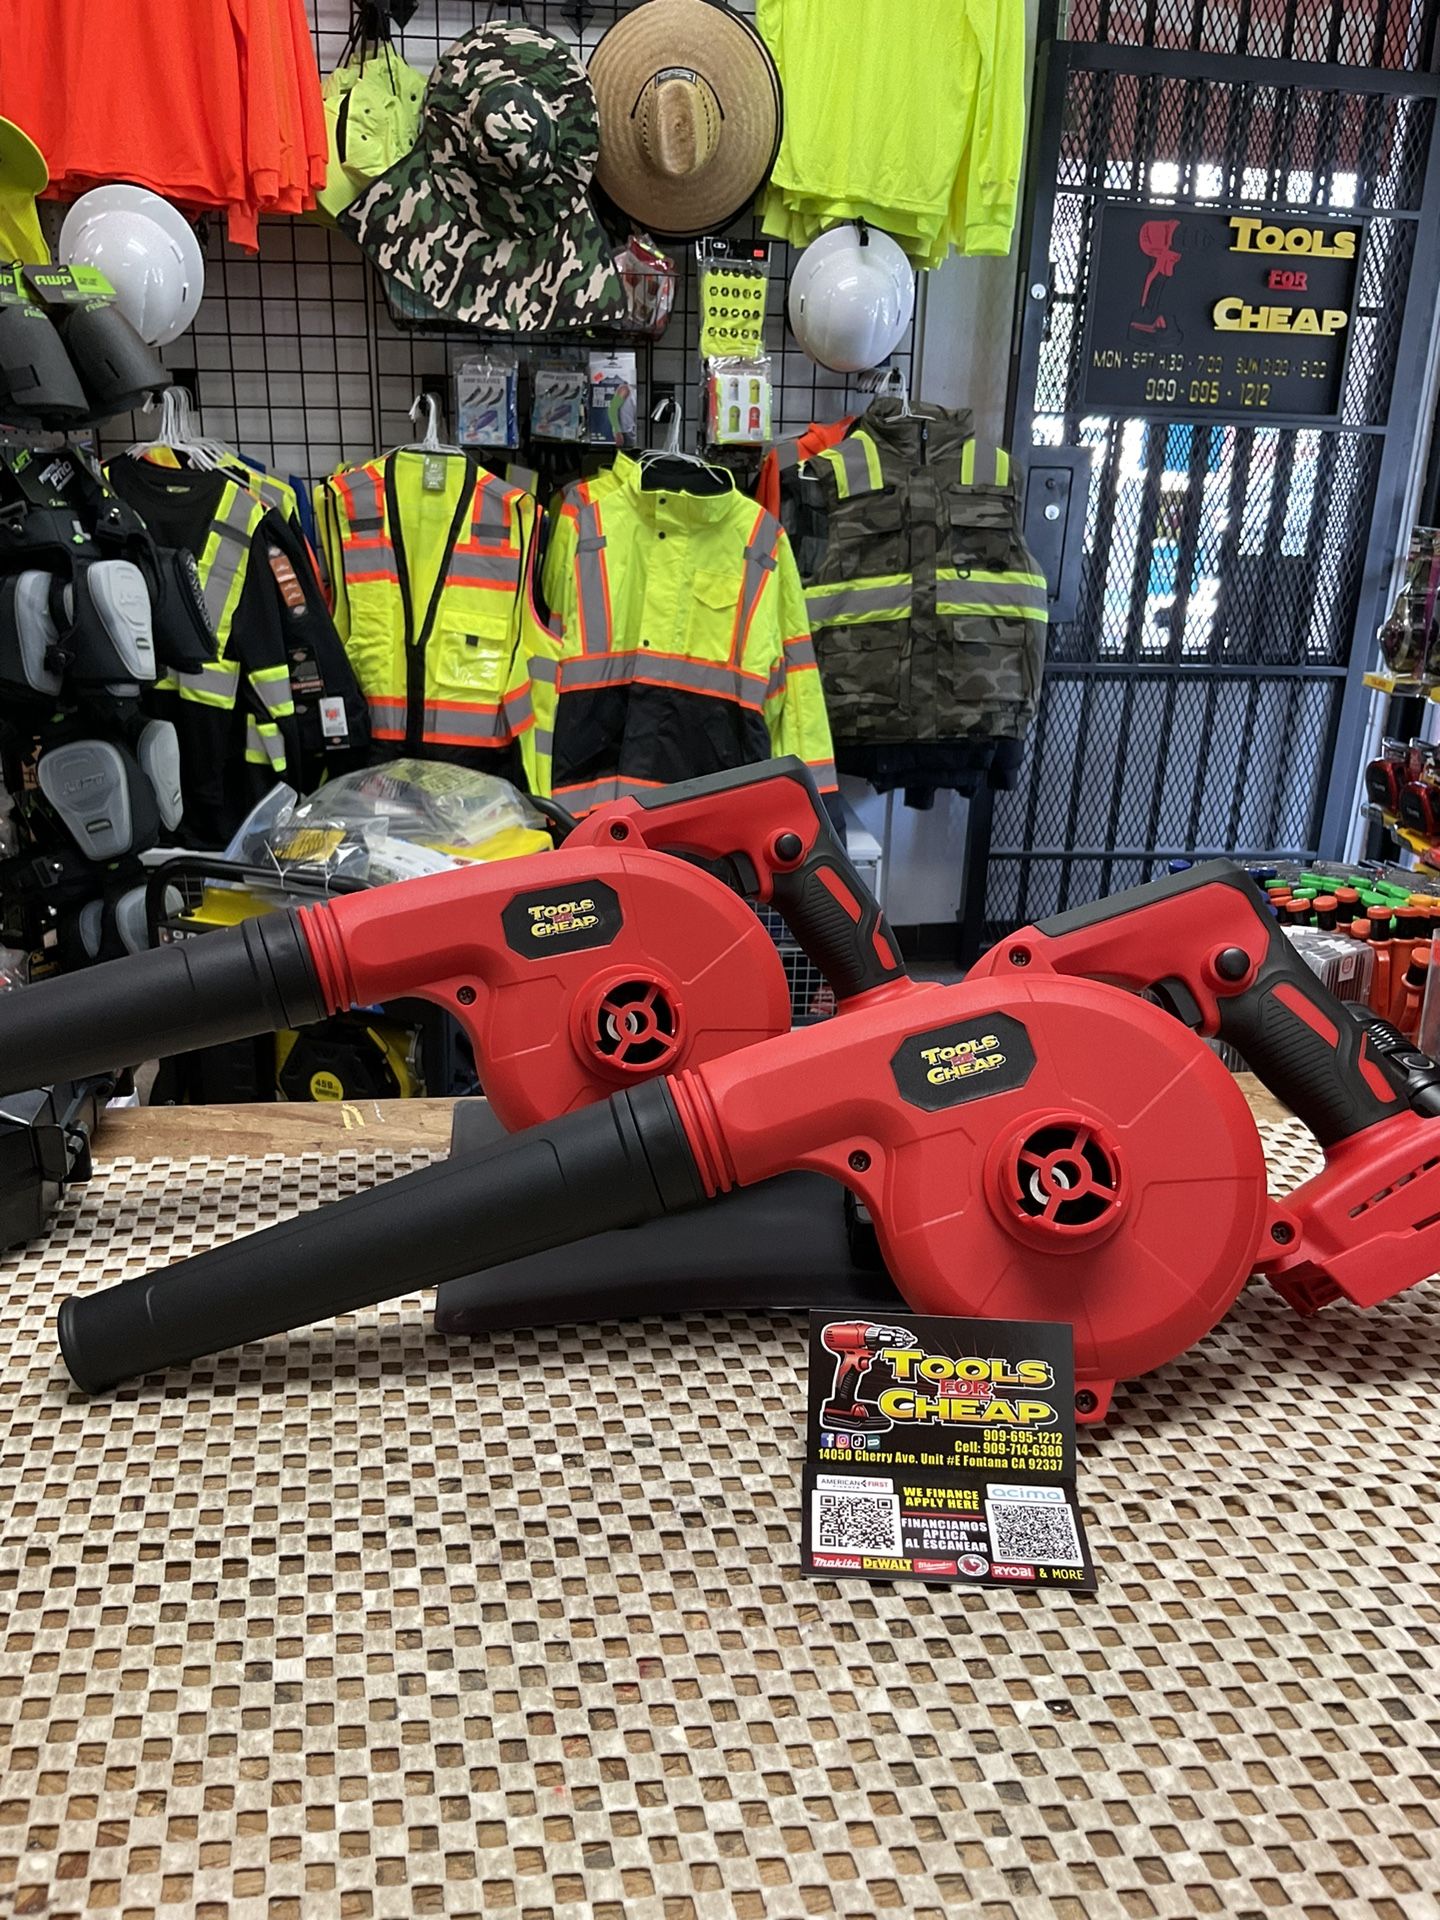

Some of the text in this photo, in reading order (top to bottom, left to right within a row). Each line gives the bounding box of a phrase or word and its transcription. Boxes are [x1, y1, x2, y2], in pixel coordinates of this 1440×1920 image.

[1229, 216, 1356, 258] TOOLS
[1268, 269, 1308, 291] FOR
[1213, 297, 1348, 335] CHEAP
[528, 898, 595, 921] TOOLS
[531, 915, 599, 938] CHEAP
[920, 1034, 1000, 1066] TOOLS
[927, 1053, 1007, 1086] CHEAP
[881, 1348, 1053, 1387] TOOLS
[938, 1379, 992, 1398] FOR
[879, 1389, 1054, 1425] CHEAP
[983, 1429, 1063, 1445] 909-695-1212
[955, 1440, 1063, 1457] Cell: 909-714-6380
[818, 1448, 1063, 1471] 14050 Cherry Ave. Unit #E Fontana CA 92337
[821, 1478, 889, 1488] AMERICAN FIRST
[902, 1486, 979, 1500] WE FINANCE
[991, 1488, 1061, 1500] acima
[905, 1497, 979, 1510] APPLY HERE
[901, 1517, 988, 1532] FINANCIAMOS
[923, 1529, 969, 1541] APLICA
[905, 1538, 988, 1552] AL ESCANEAR
[992, 1565, 1034, 1577] RYOBI
[1039, 1567, 1085, 1580] & MORE
